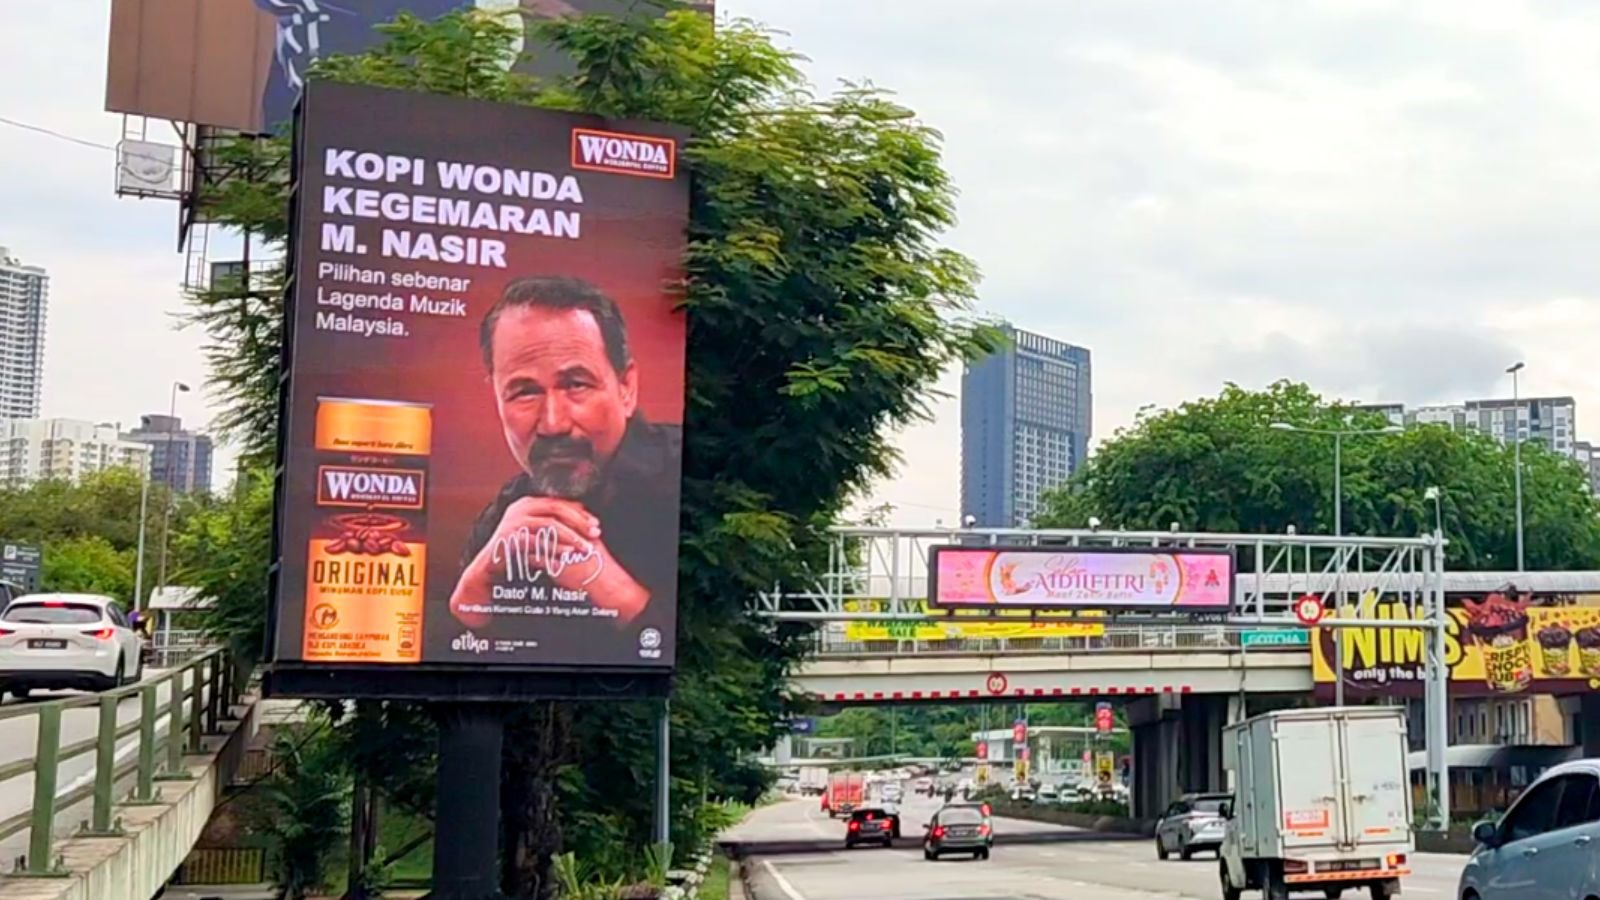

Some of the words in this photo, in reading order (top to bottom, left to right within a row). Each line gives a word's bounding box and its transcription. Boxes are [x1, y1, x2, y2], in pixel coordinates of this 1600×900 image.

[578, 135, 668, 165] WONDA
[324, 149, 424, 185] KOPI
[438, 162, 583, 204] WONDA
[323, 186, 581, 239] KEGEMARAN
[321, 223, 367, 255] M.
[382, 231, 508, 268] NASIR
[318, 263, 386, 285] Pilihan
[391, 270, 471, 292] sebenar
[317, 287, 404, 312] Lagenda
[410, 295, 467, 317] Muzik
[316, 312, 410, 337] Malaysia.
[324, 471, 417, 499] WONDA
[313, 560, 420, 587] ORIGINAL
[492, 585, 528, 600] Dato'
[530, 587, 549, 601] M.
[552, 587, 588, 602] Nasir
[452, 629, 489, 655] etika
[1247, 633, 1300, 644] GOTCHA
[1353, 666, 1387, 682] only
[1389, 666, 1414, 680] the
